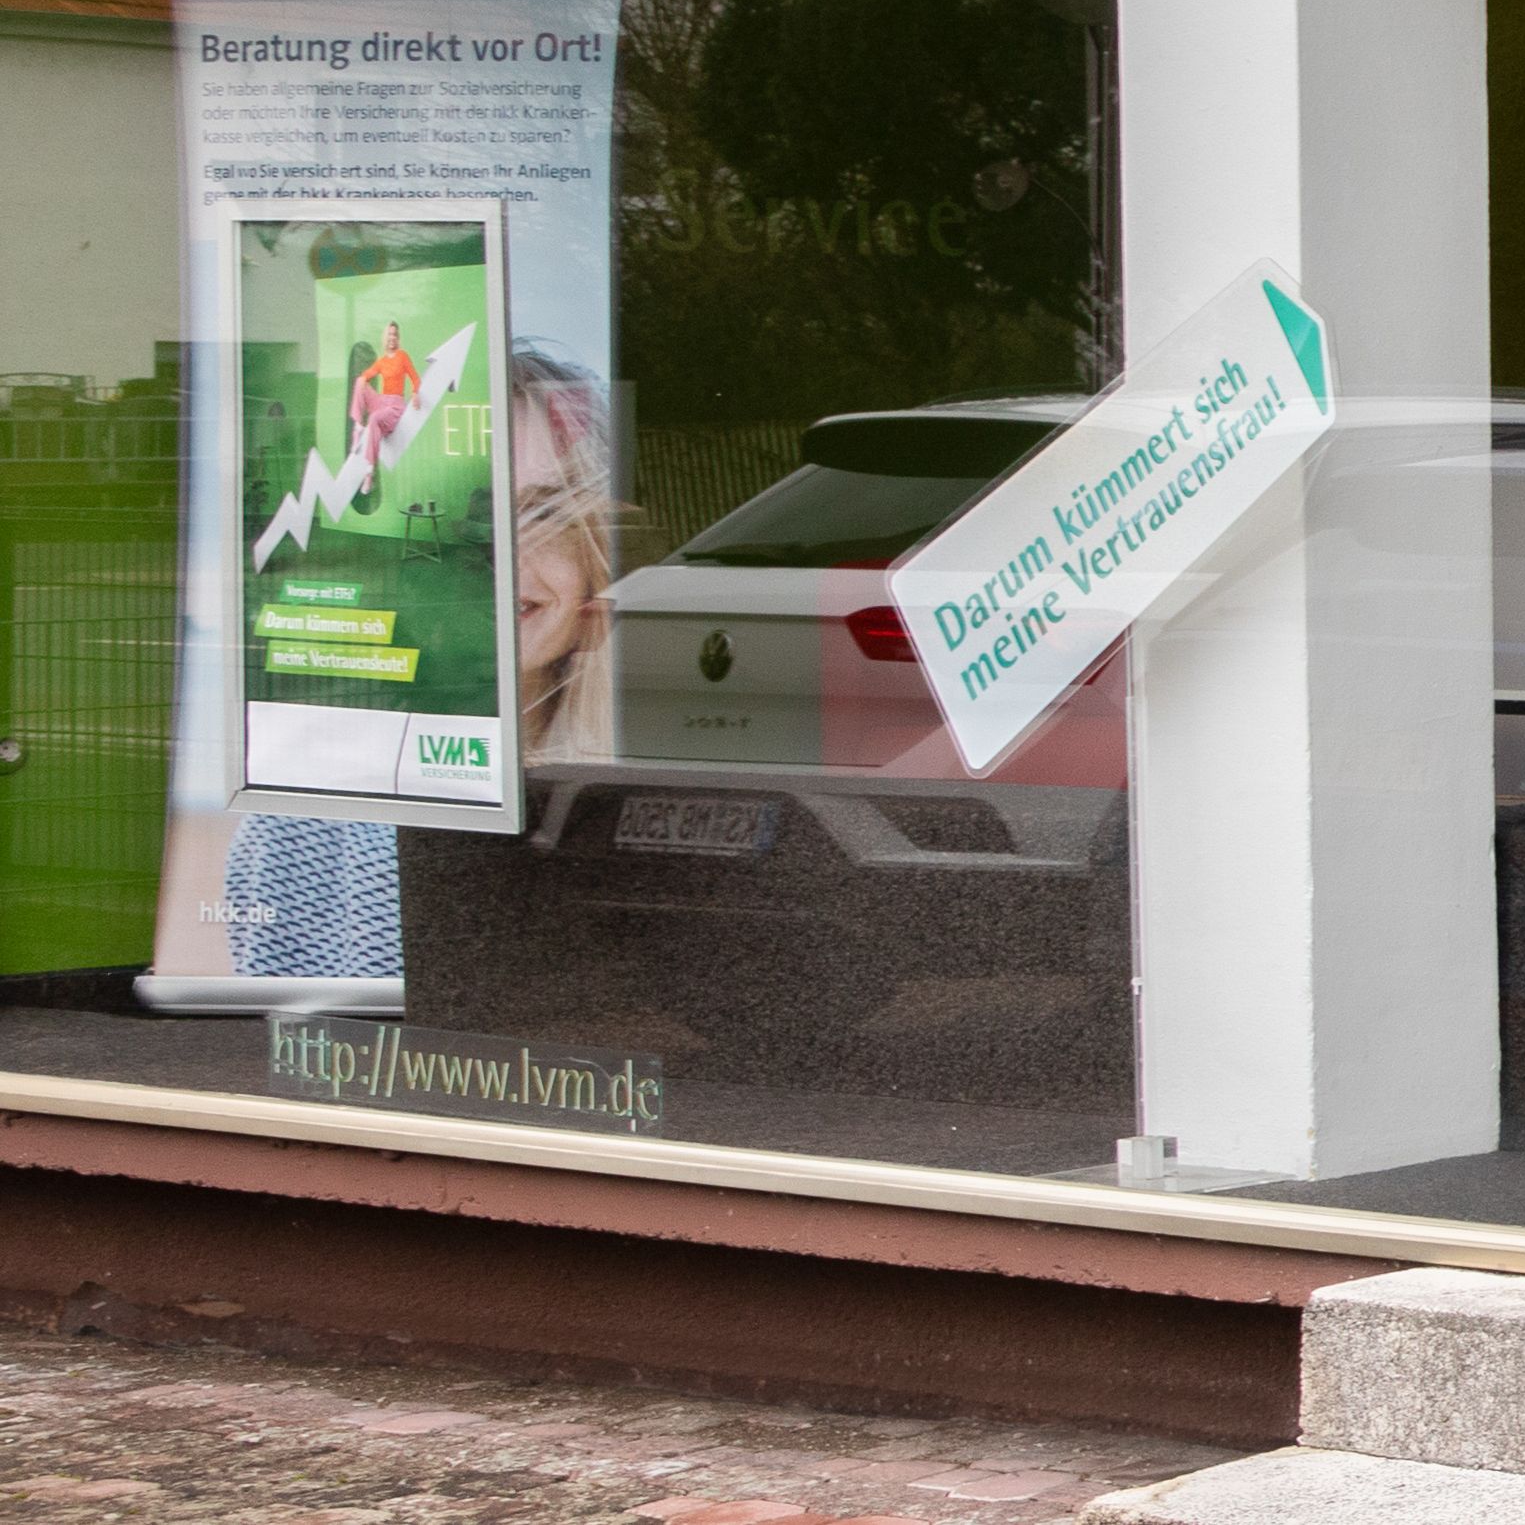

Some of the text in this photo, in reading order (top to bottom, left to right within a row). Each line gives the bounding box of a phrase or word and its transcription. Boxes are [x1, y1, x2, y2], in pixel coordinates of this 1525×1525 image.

[201, 31, 602, 70] Beratung direkt vor Ort!
[202, 81, 583, 100] Sie haben allgemeine Fragen zur Sozialversicherung
[203, 106, 598, 123] oder möchten Ihre Versicherung mit der hkk Kranken-
[203, 129, 572, 147] kasse vergleichen, um eventuell Kosten zu sparen?
[204, 163, 592, 182] Egal wo Sie versichert sind, Sie können Ihr Anliegen
[933, 356, 1249, 652] Darum kümmert sich
[959, 374, 1287, 701] meine Vertrauensfrau!
[264, 611, 387, 636] Darum kümmern sich
[272, 648, 408, 673] meine Vertrauensleute!
[418, 734, 466, 766] LVM
[420, 767, 492, 782] VERSICHERUNG
[199, 900, 278, 923] hkk.de
[271, 1018, 659, 1122] http://www.lvm.de
